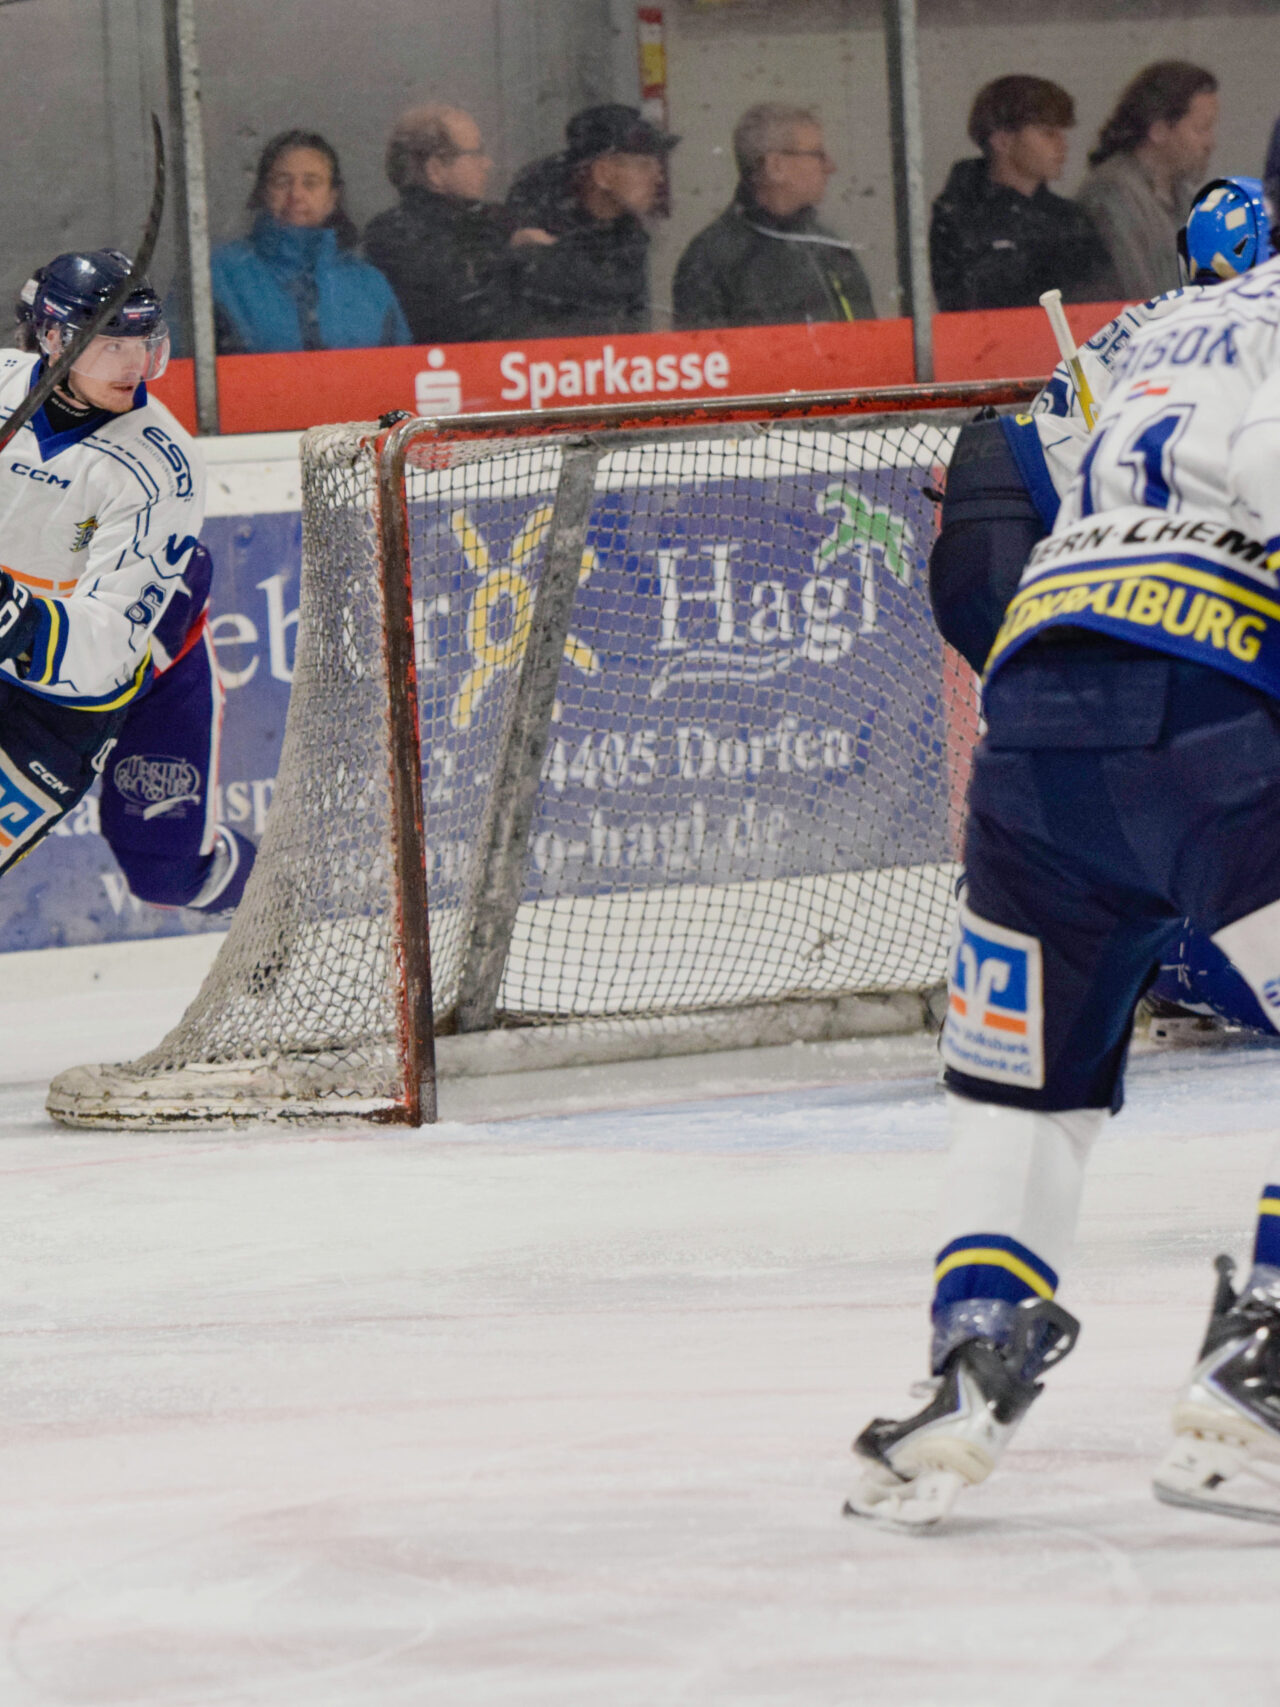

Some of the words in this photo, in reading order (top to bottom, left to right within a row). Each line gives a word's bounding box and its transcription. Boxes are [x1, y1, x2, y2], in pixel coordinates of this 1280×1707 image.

[500, 346, 730, 409] Sparkasse
[10, 462, 72, 490] CCM
[650, 543, 880, 663] Hagl
[29, 760, 70, 794] CCM
[540, 731, 660, 792] 4405
[675, 717, 851, 780] Dorfen
